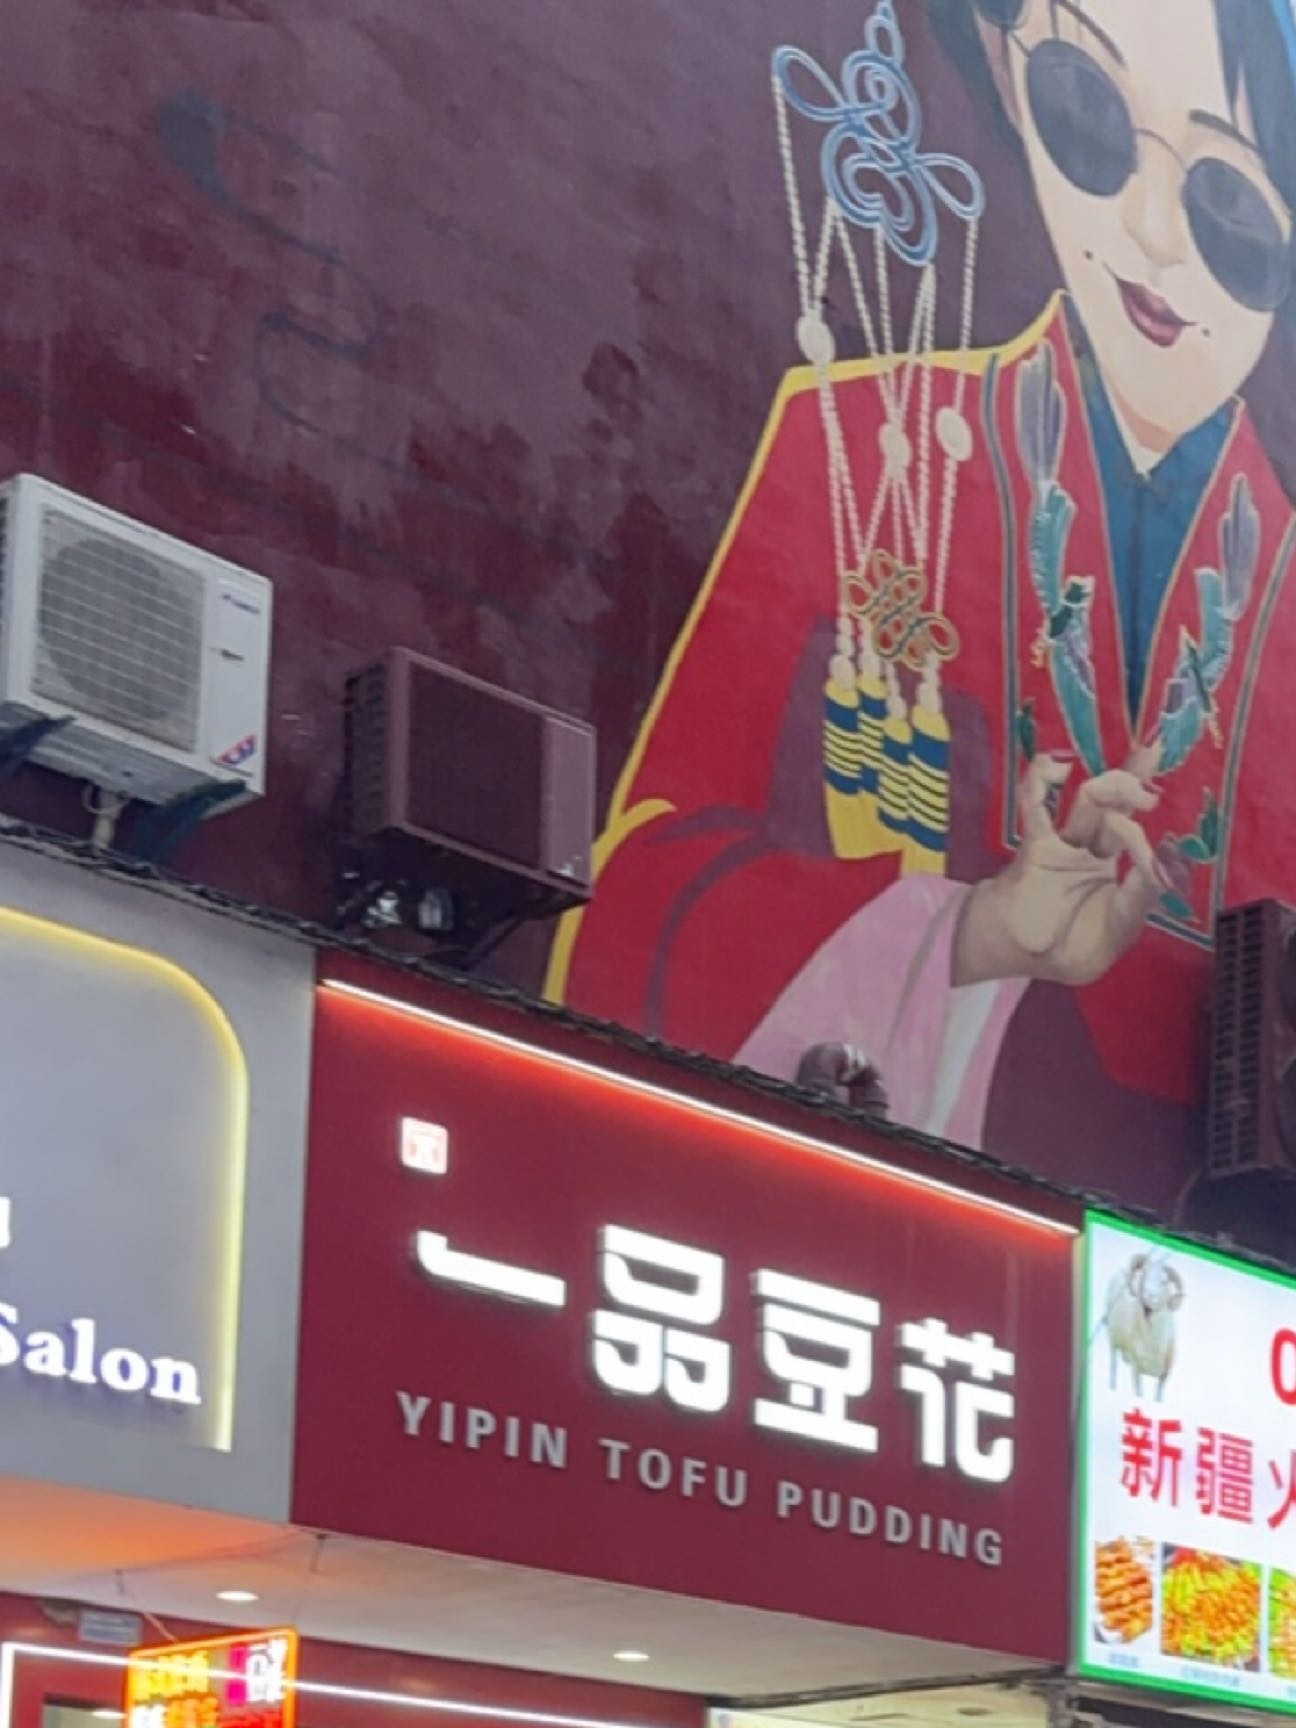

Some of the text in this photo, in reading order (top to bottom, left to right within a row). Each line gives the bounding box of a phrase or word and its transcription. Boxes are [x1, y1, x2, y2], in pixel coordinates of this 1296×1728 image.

[413, 1223, 1014, 1483] 一品豆花
[396, 1390, 1002, 1566] YIPIN TOFU PUDDING
